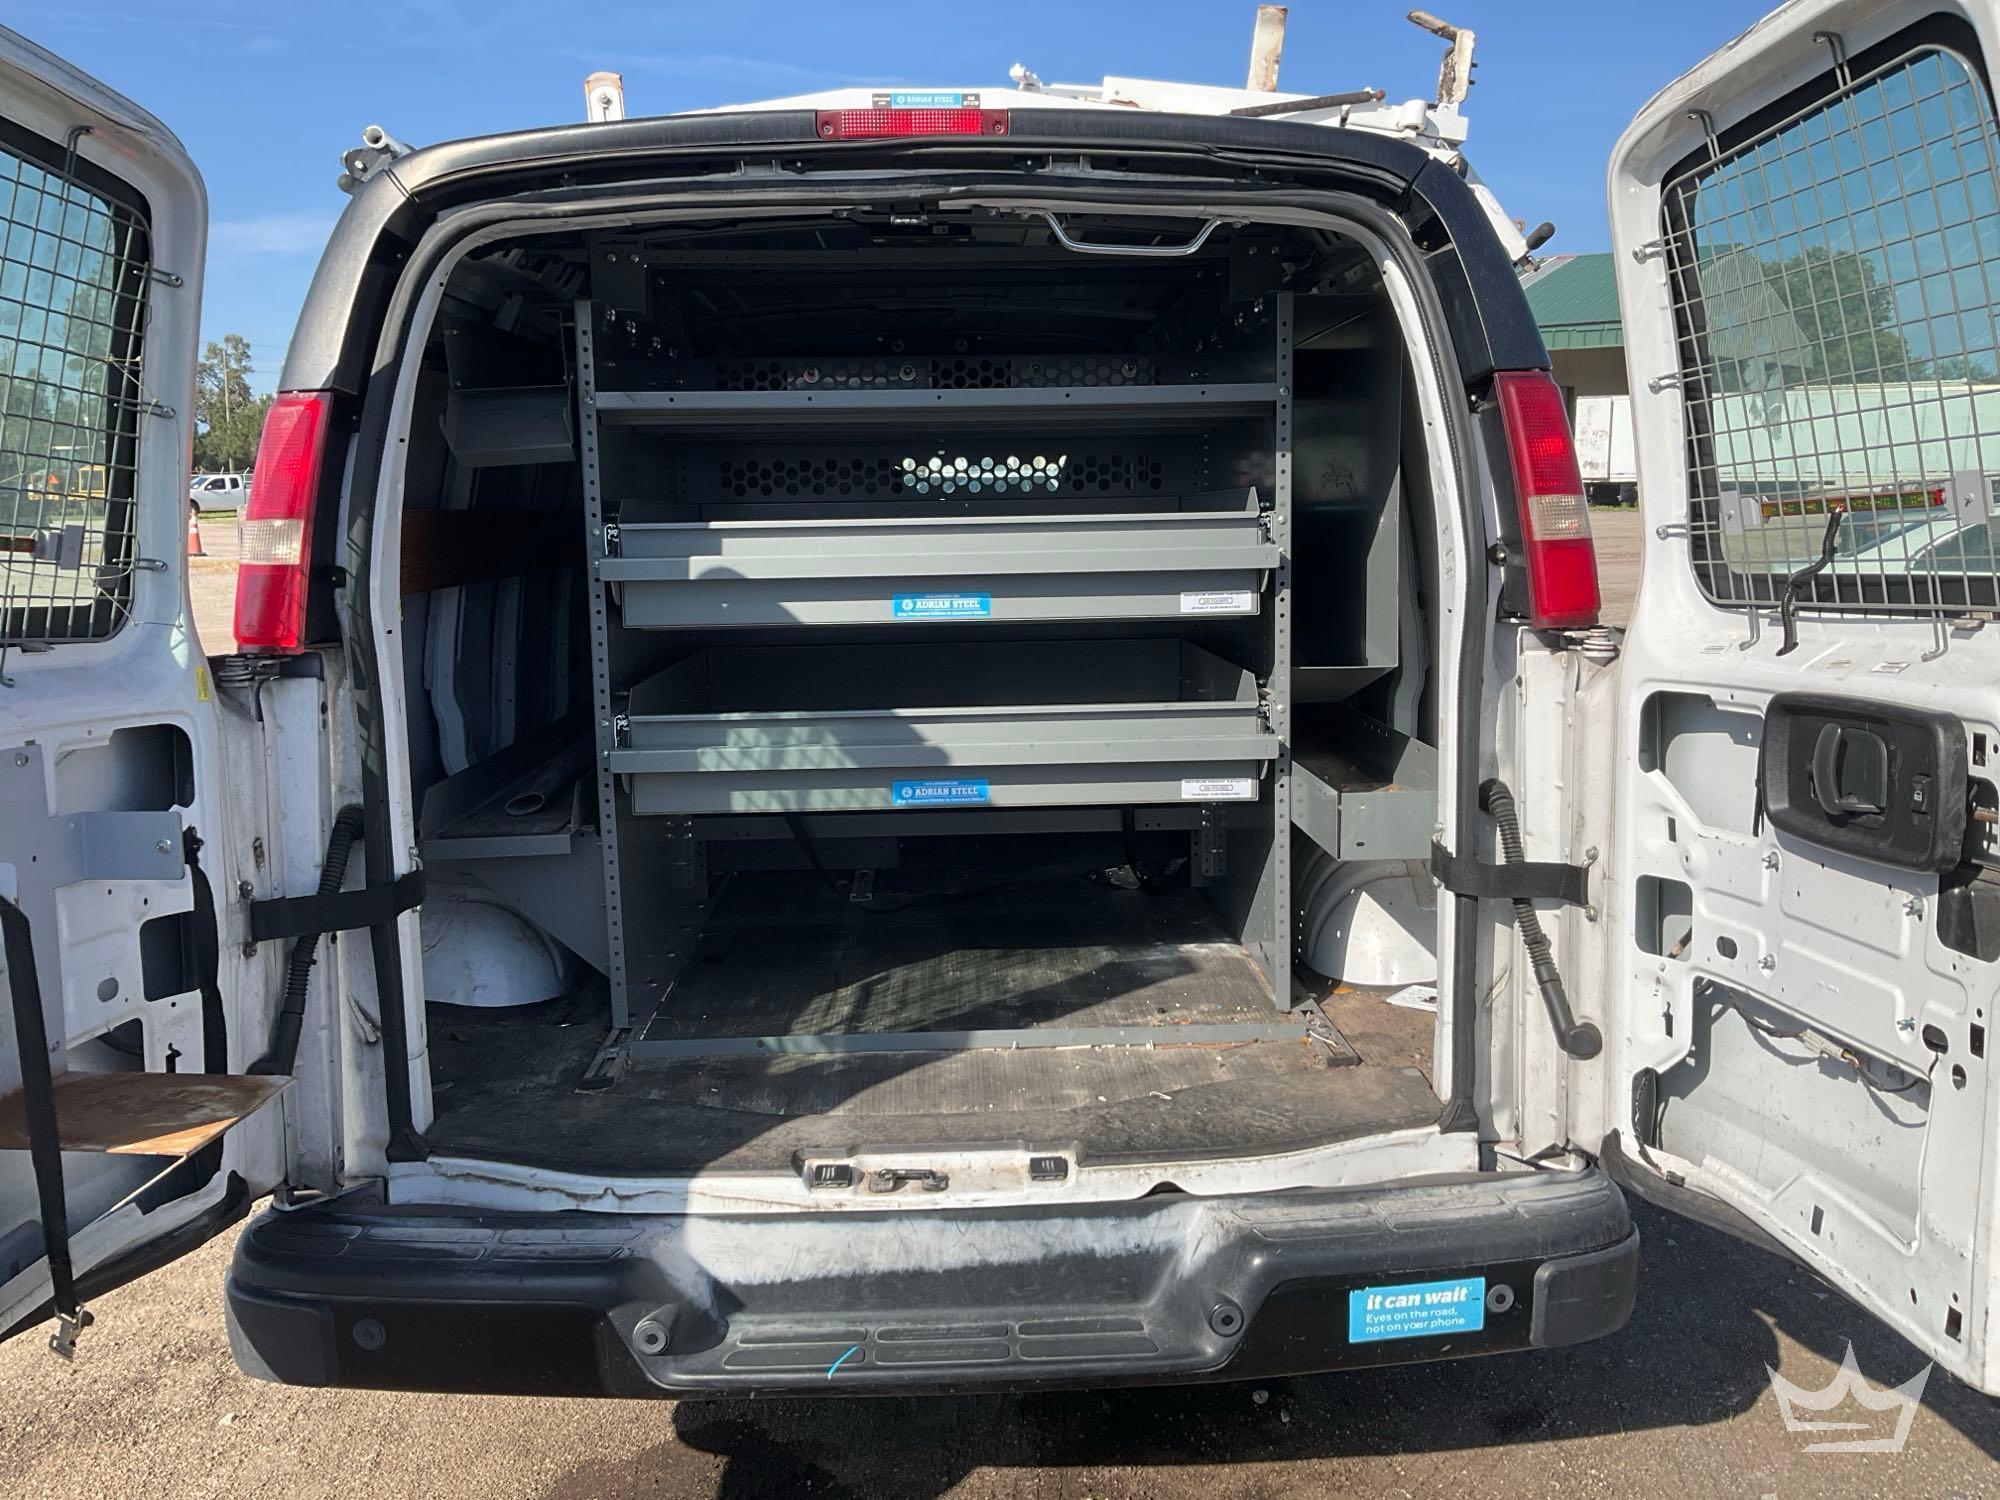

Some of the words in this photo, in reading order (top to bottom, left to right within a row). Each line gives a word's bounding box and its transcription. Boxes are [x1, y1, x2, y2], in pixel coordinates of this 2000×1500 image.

[906, 95, 932, 103] ADRIAN
[934, 95, 955, 103] STEEL
[915, 600, 950, 609] ADRIAN
[952, 599, 980, 608] STEEL
[915, 787, 949, 796] ADRIAN
[950, 787, 979, 795] STEEL
[1366, 1294, 1381, 1311] it
[1384, 1294, 1421, 1309] can
[1424, 1286, 1469, 1305] wait
[1366, 1313, 1392, 1324] Eyes
[1393, 1312, 1408, 1321] on
[1409, 1309, 1428, 1319] the
[1430, 1306, 1458, 1317] road,
[1366, 1324, 1385, 1334] not
[1387, 1323, 1402, 1332] on
[1403, 1320, 1429, 1331] your
[1430, 1316, 1466, 1329] phone
